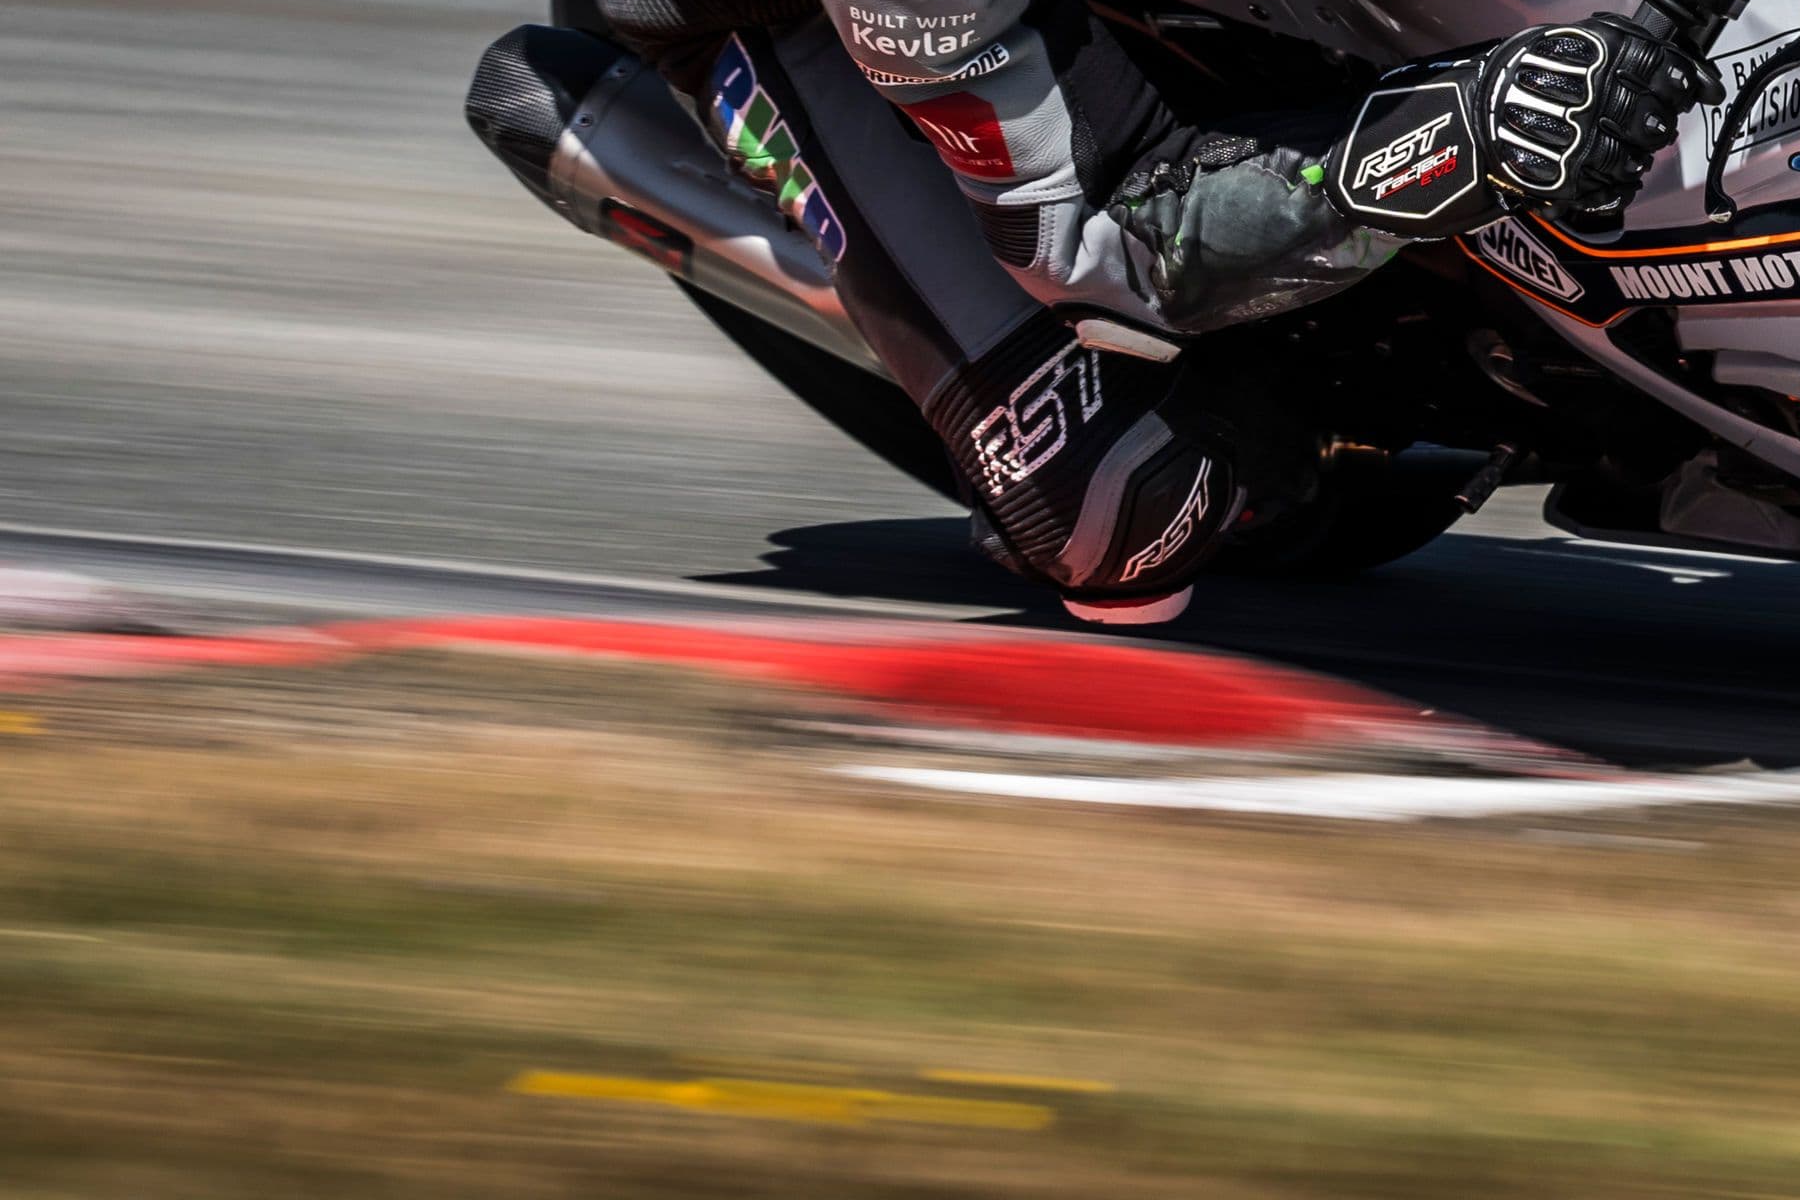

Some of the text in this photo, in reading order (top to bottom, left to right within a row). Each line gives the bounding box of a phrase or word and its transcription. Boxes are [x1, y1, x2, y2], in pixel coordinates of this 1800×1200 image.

[850, 2, 977, 31] BUILT WITH
[852, 12, 975, 58] Kevlar
[1353, 112, 1453, 190] RST
[1421, 157, 1457, 187] EVO
[1609, 257, 1731, 300] MOUNT
[1118, 456, 1213, 582] RST
